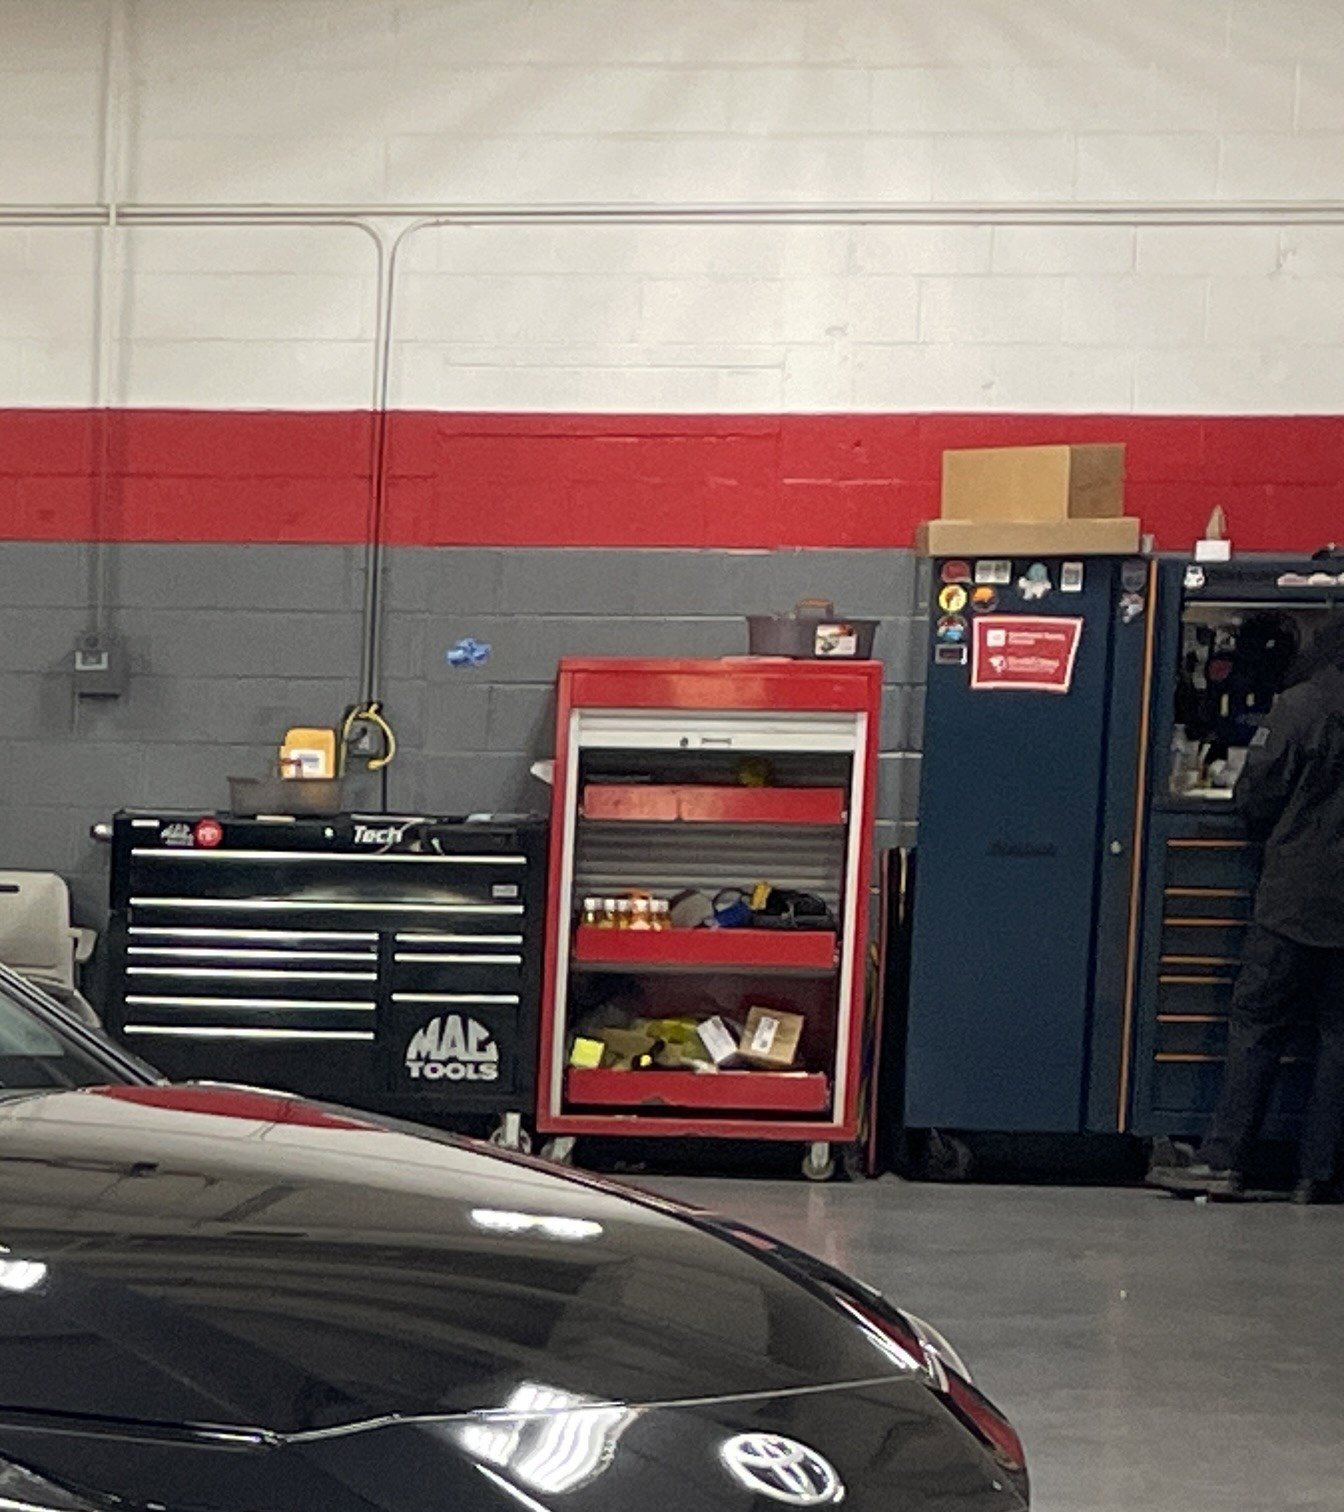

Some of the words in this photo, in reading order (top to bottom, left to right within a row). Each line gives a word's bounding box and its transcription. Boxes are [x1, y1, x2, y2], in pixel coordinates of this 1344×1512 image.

[354, 825, 402, 844] Tech
[405, 1014, 499, 1062] MAC
[404, 1061, 499, 1081] TOOLS
